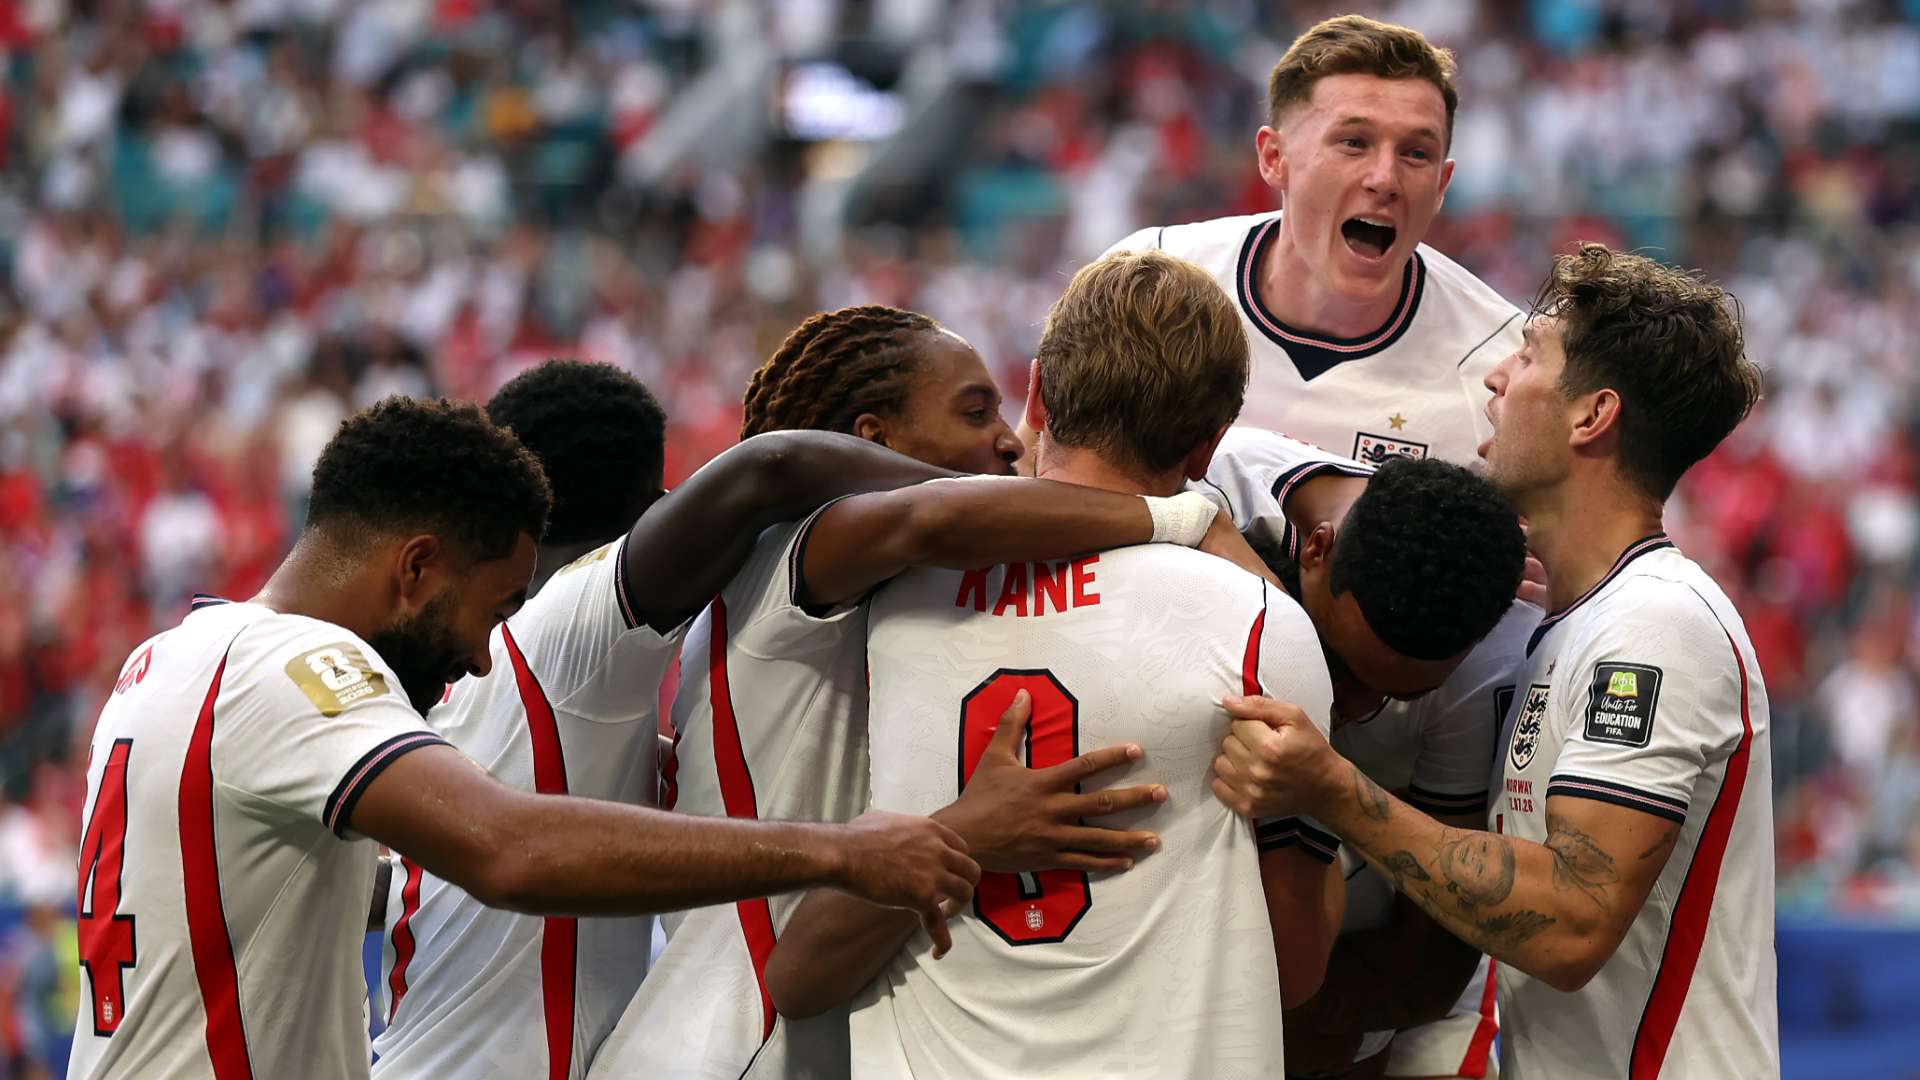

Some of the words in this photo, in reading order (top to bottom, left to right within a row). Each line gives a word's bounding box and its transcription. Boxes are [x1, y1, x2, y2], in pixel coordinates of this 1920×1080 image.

[955, 554, 1101, 617] KANE
[1601, 696, 1623, 711] Unite
[1623, 698, 1638, 713] For
[1594, 711, 1642, 730] EDUCATION
[1605, 726, 1623, 737] FIFA
[1506, 778, 1533, 796] NORWAY
